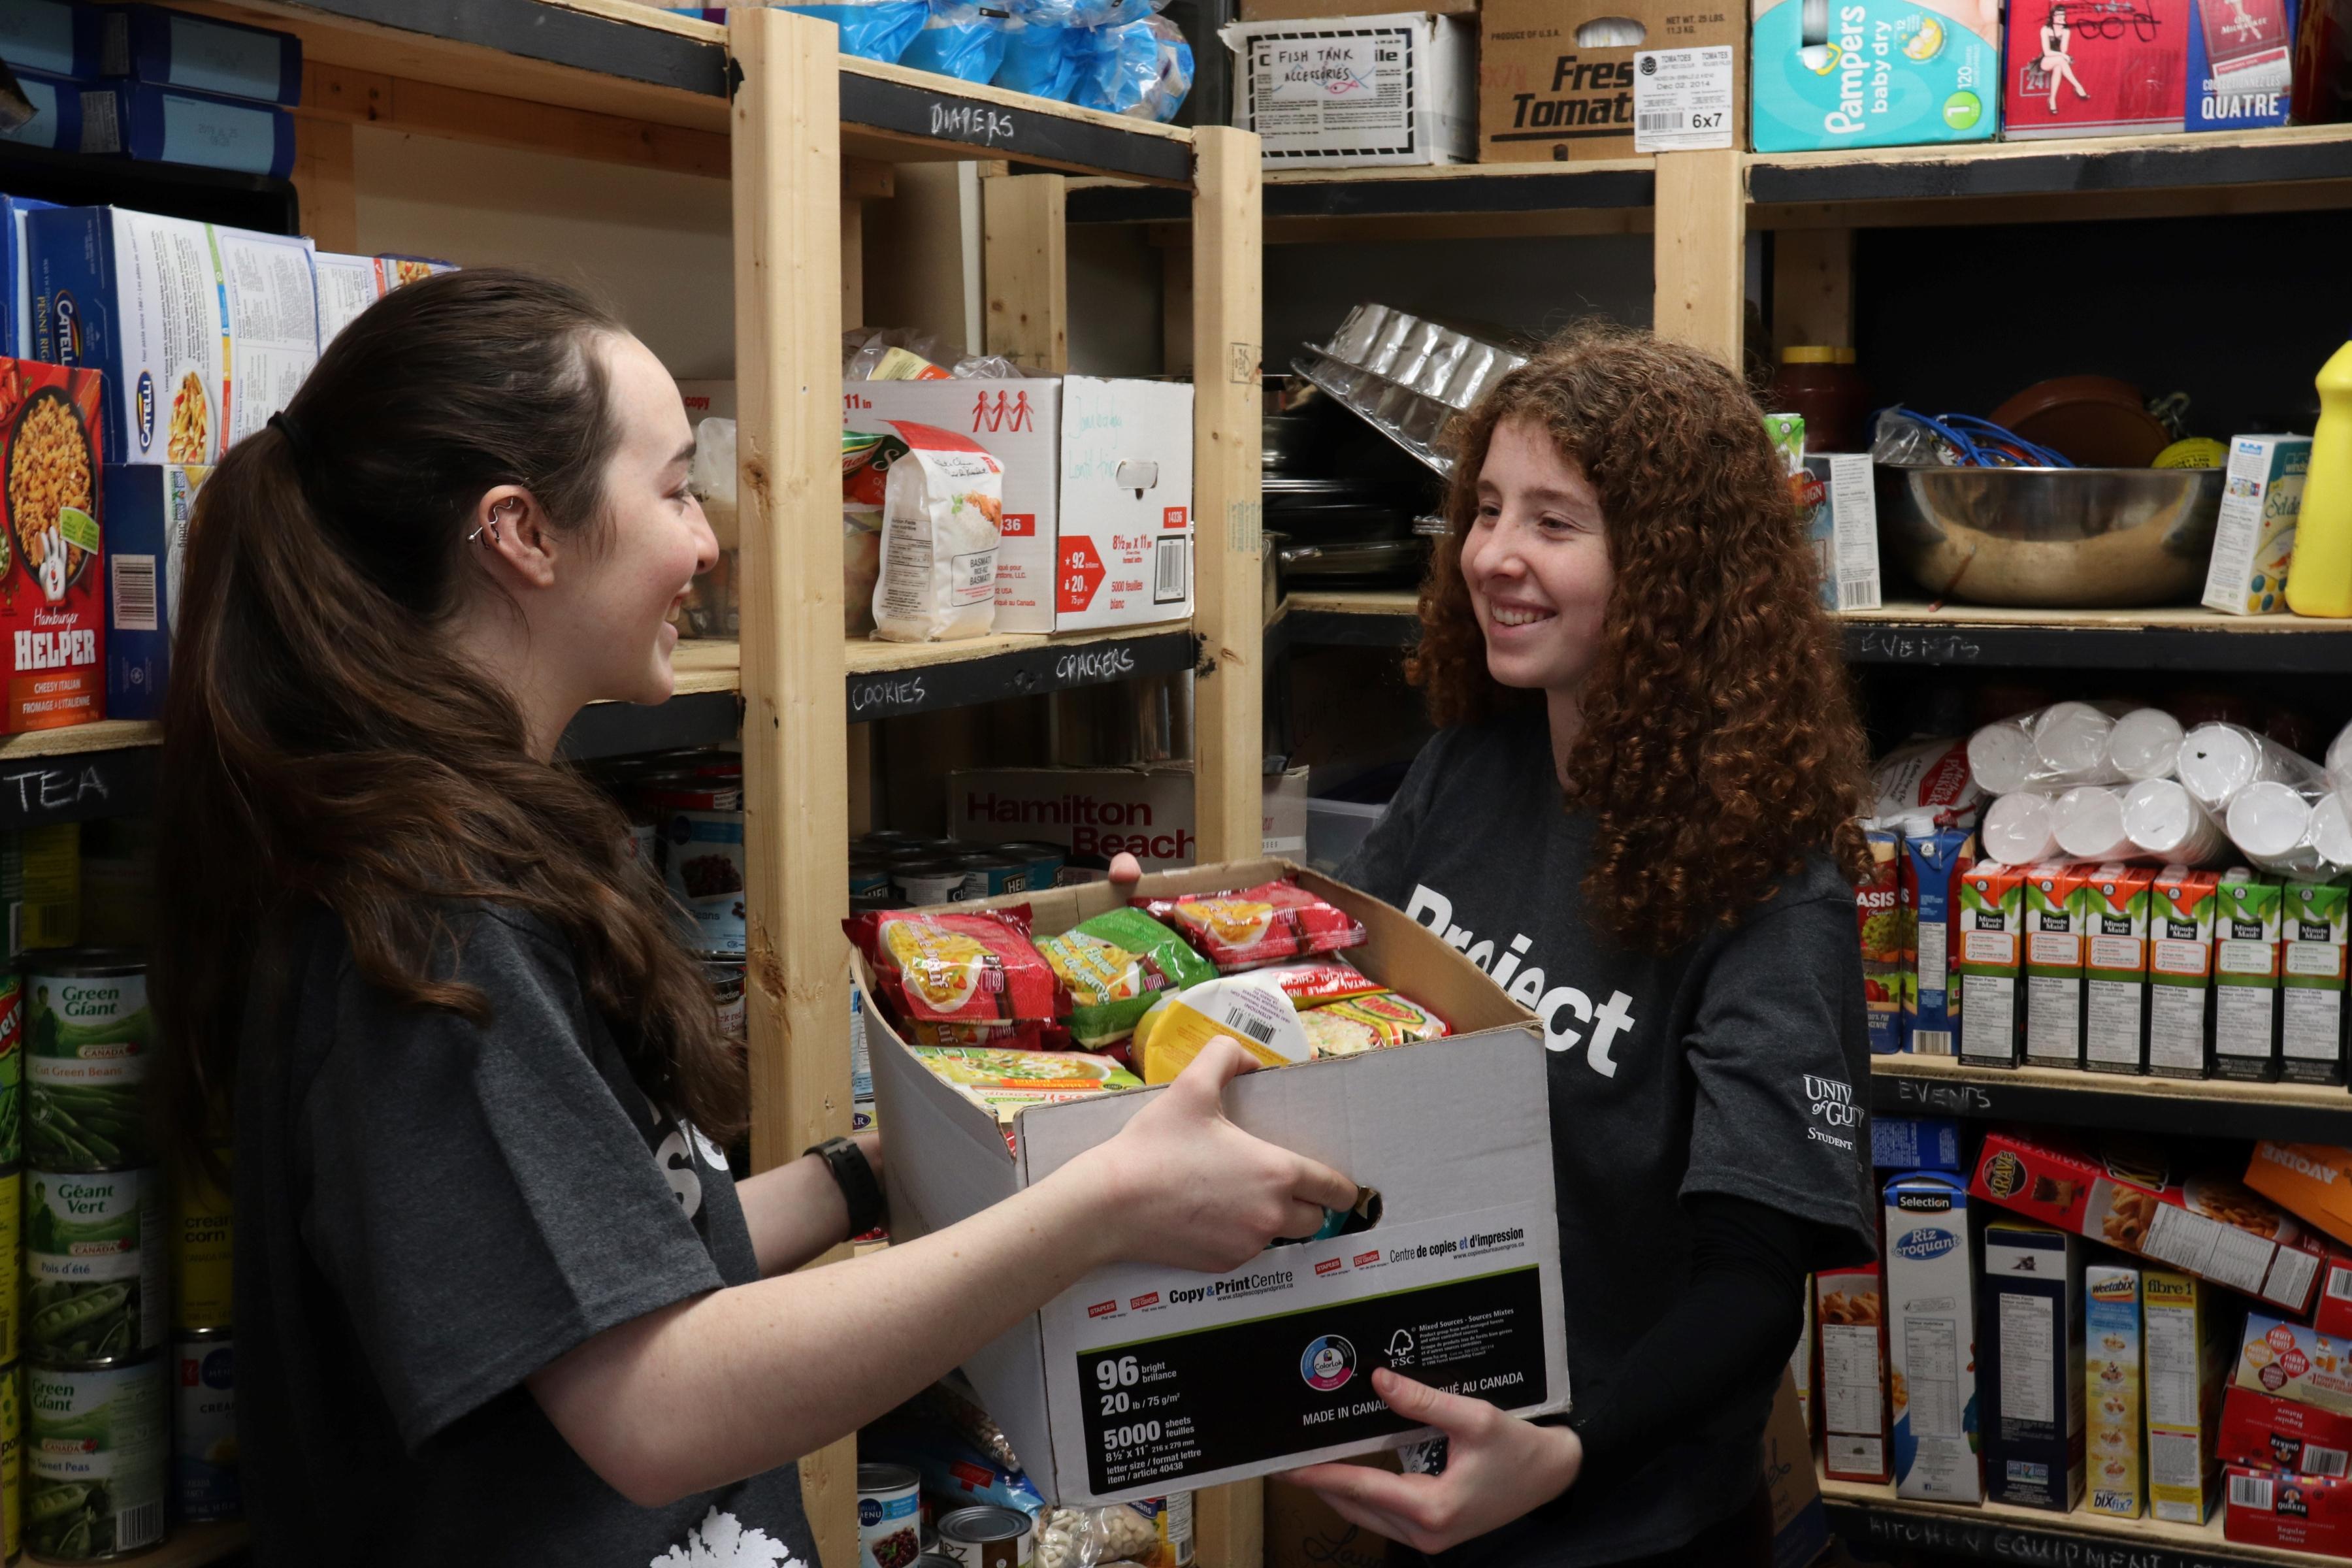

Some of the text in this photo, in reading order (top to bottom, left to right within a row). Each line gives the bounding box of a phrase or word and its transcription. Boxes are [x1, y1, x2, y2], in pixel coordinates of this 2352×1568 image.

[1666, 14, 1725, 24] NET WT. 25 LBS.
[1897, 19, 1906, 31] 12
[1491, 29, 1560, 41] PRODUCE OF U.S.A.
[1667, 26, 1682, 35] 11.3
[1279, 48, 1354, 63] FISH TANK
[1284, 67, 1350, 82] ACCESSORIES
[1824, 5, 1871, 134] Pampers
[1870, 20, 1892, 114] baby dry
[1957, 65, 1972, 89] 120
[1946, 105, 1970, 118] 1
[2201, 93, 2280, 120] QUATRE
[930, 102, 1014, 146] DIAPERS
[1692, 112, 1722, 128] 6x7
[36, 295, 48, 333] PENNE
[684, 395, 710, 410] copy
[843, 394, 872, 409] 11 in
[140, 379, 153, 448] CATELLI
[1168, 511, 1183, 523] 14336
[1140, 534, 1147, 549] 11
[970, 556, 992, 567] BASMATI
[1072, 551, 1085, 568] 92
[970, 575, 991, 585] BASMATI
[1071, 575, 1084, 592] 20
[1111, 580, 1143, 592] 5000 feuilles
[1111, 598, 1124, 609] blanc
[33, 607, 78, 632] Hamburger
[14, 629, 97, 671] HELPER
[1861, 634, 1980, 660] EVENTS
[34, 679, 82, 694] CHEESY ITALIAN
[852, 647, 1134, 711] COOKIES CRACKERS
[23, 698, 54, 715] FROMAGE
[3, 766, 109, 813] TEA
[1942, 766, 1964, 804] Mother
[968, 792, 1152, 826] Hamilton
[1072, 826, 1195, 859] Beach
[1978, 915, 2002, 924] Minute
[2042, 916, 2067, 925] Minute
[2104, 920, 2129, 928] Minute
[2170, 924, 2195, 933] Minute
[2234, 924, 2261, 933] Minute
[2301, 926, 2328, 934] Minute
[61, 985, 120, 1002] Green
[65, 1002, 117, 1017] Giant
[1243, 1002, 1273, 1021] ATTENTION!
[84, 1049, 125, 1058] CANADA
[35, 1064, 124, 1078] Cut Green Beans
[1899, 1080, 1991, 1108] EVENTS
[1812, 1100, 1829, 1115] of
[1808, 1127, 1853, 1151] STUDENT
[2261, 1145, 2340, 1184] AVOINE
[1991, 1151, 2016, 1198] KRAVE
[57, 1184, 115, 1198] Géant
[67, 1200, 106, 1215] Vert
[1900, 1196, 1950, 1209] Selection
[184, 1230, 225, 1244] corn
[1911, 1228, 1936, 1243] Riz
[74, 1245, 116, 1254] CANADA
[1316, 1228, 1524, 1272] STAPLES Centre de copies et d'impression
[1452, 1241, 1525, 1260] www.copiesbureauengros.ca
[1895, 1235, 1959, 1257] croquant
[41, 1262, 59, 1275] Pois
[1217, 1282, 1294, 1302] www.staplescopyandprint.ca
[2148, 1279, 2193, 1295] fibre 1
[1089, 1302, 1115, 1315] STAPLES
[1419, 1307, 1515, 1332] Mixed Sources Sources Mixtes
[2268, 1339, 2291, 1348] FRUITS
[2270, 1331, 2292, 1342] FRUIT
[1314, 1360, 1343, 1371] ColorLok
[1390, 1355, 1415, 1368] FSC
[2283, 1361, 2306, 1373] FIBRES
[2284, 1354, 2307, 1365] FIBRE
[1096, 1356, 1166, 1391] 96 bright
[1142, 1369, 1177, 1383] brillance
[32, 1379, 74, 1397] Green
[1462, 1379, 1477, 1394] AU
[1479, 1371, 1524, 1390] CANADA
[34, 1396, 73, 1412] Giant
[1100, 1392, 1181, 1416] 20 lb 75 g/m²
[1303, 1405, 1349, 1426] MADE IN
[2277, 1407, 2302, 1420] Nature
[2274, 1414, 2303, 1429] Regular
[1103, 1416, 1192, 1450] 5000 sheets
[1166, 1426, 1195, 1438] feuilles
[44, 1443, 80, 1454] CANADA
[1126, 1449, 1133, 1458] x
[1151, 1444, 1164, 1454] 216
[1169, 1440, 1181, 1450] 279
[2270, 1437, 2299, 1452] QUAKER
[65, 1462, 90, 1472] Peas
[1107, 1448, 1201, 1475] letter size format lettre
[1107, 1462, 1184, 1485] item article 40438
[2277, 1501, 2308, 1513] QUAKER
[1869, 1516, 1980, 1552] KITCHEN
[2277, 1525, 2306, 1536] Regular
[2277, 1533, 2306, 1544] Nature
